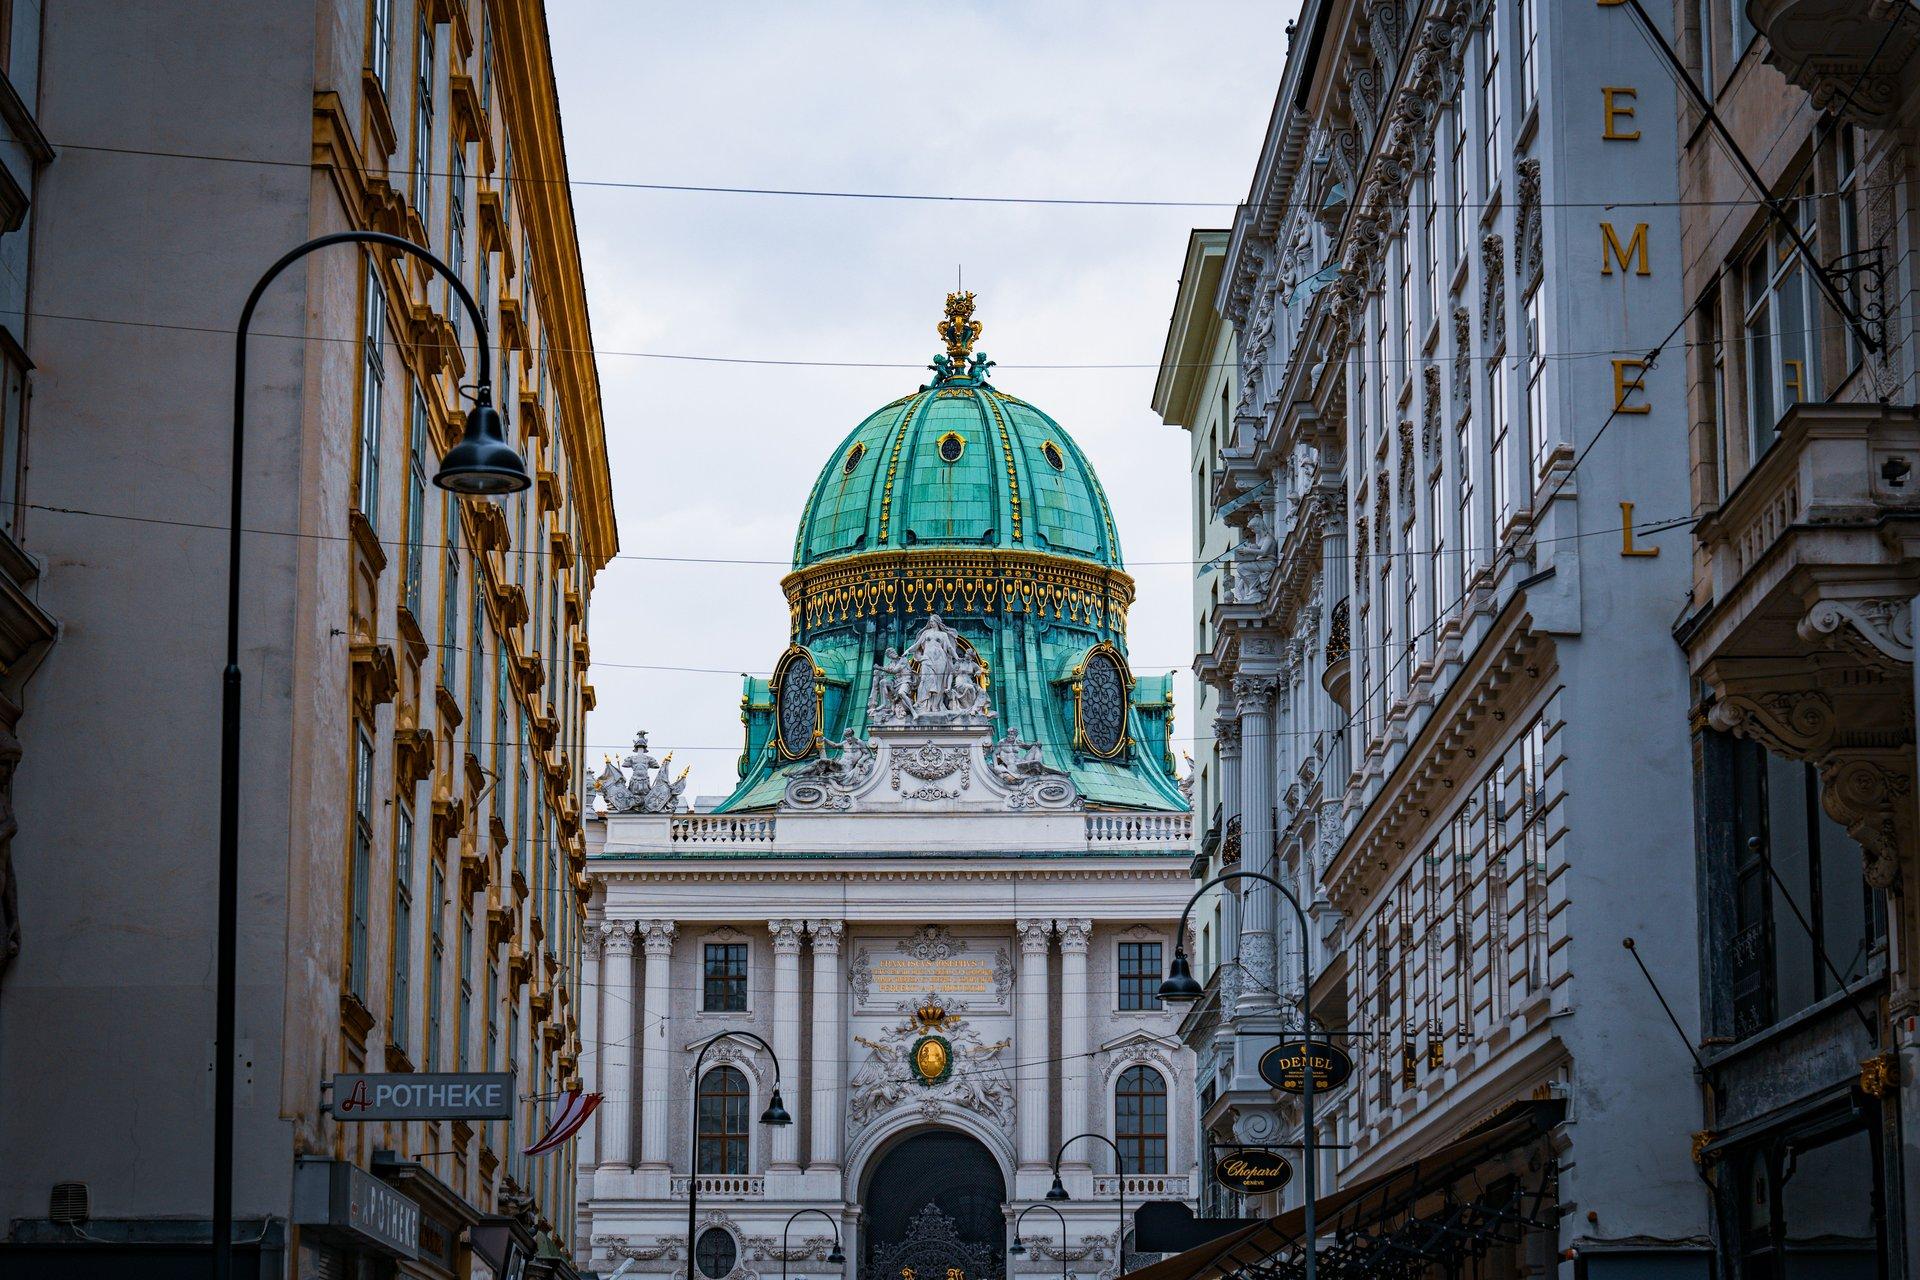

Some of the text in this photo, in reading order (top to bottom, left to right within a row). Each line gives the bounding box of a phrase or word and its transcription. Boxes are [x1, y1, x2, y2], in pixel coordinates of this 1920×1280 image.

[1597, 0, 1660, 558] EMEL
[1279, 1056, 1333, 1070] DEMEL
[341, 1080, 502, 1112] APOTHEKE
[1223, 1160, 1284, 1180] Chopard
